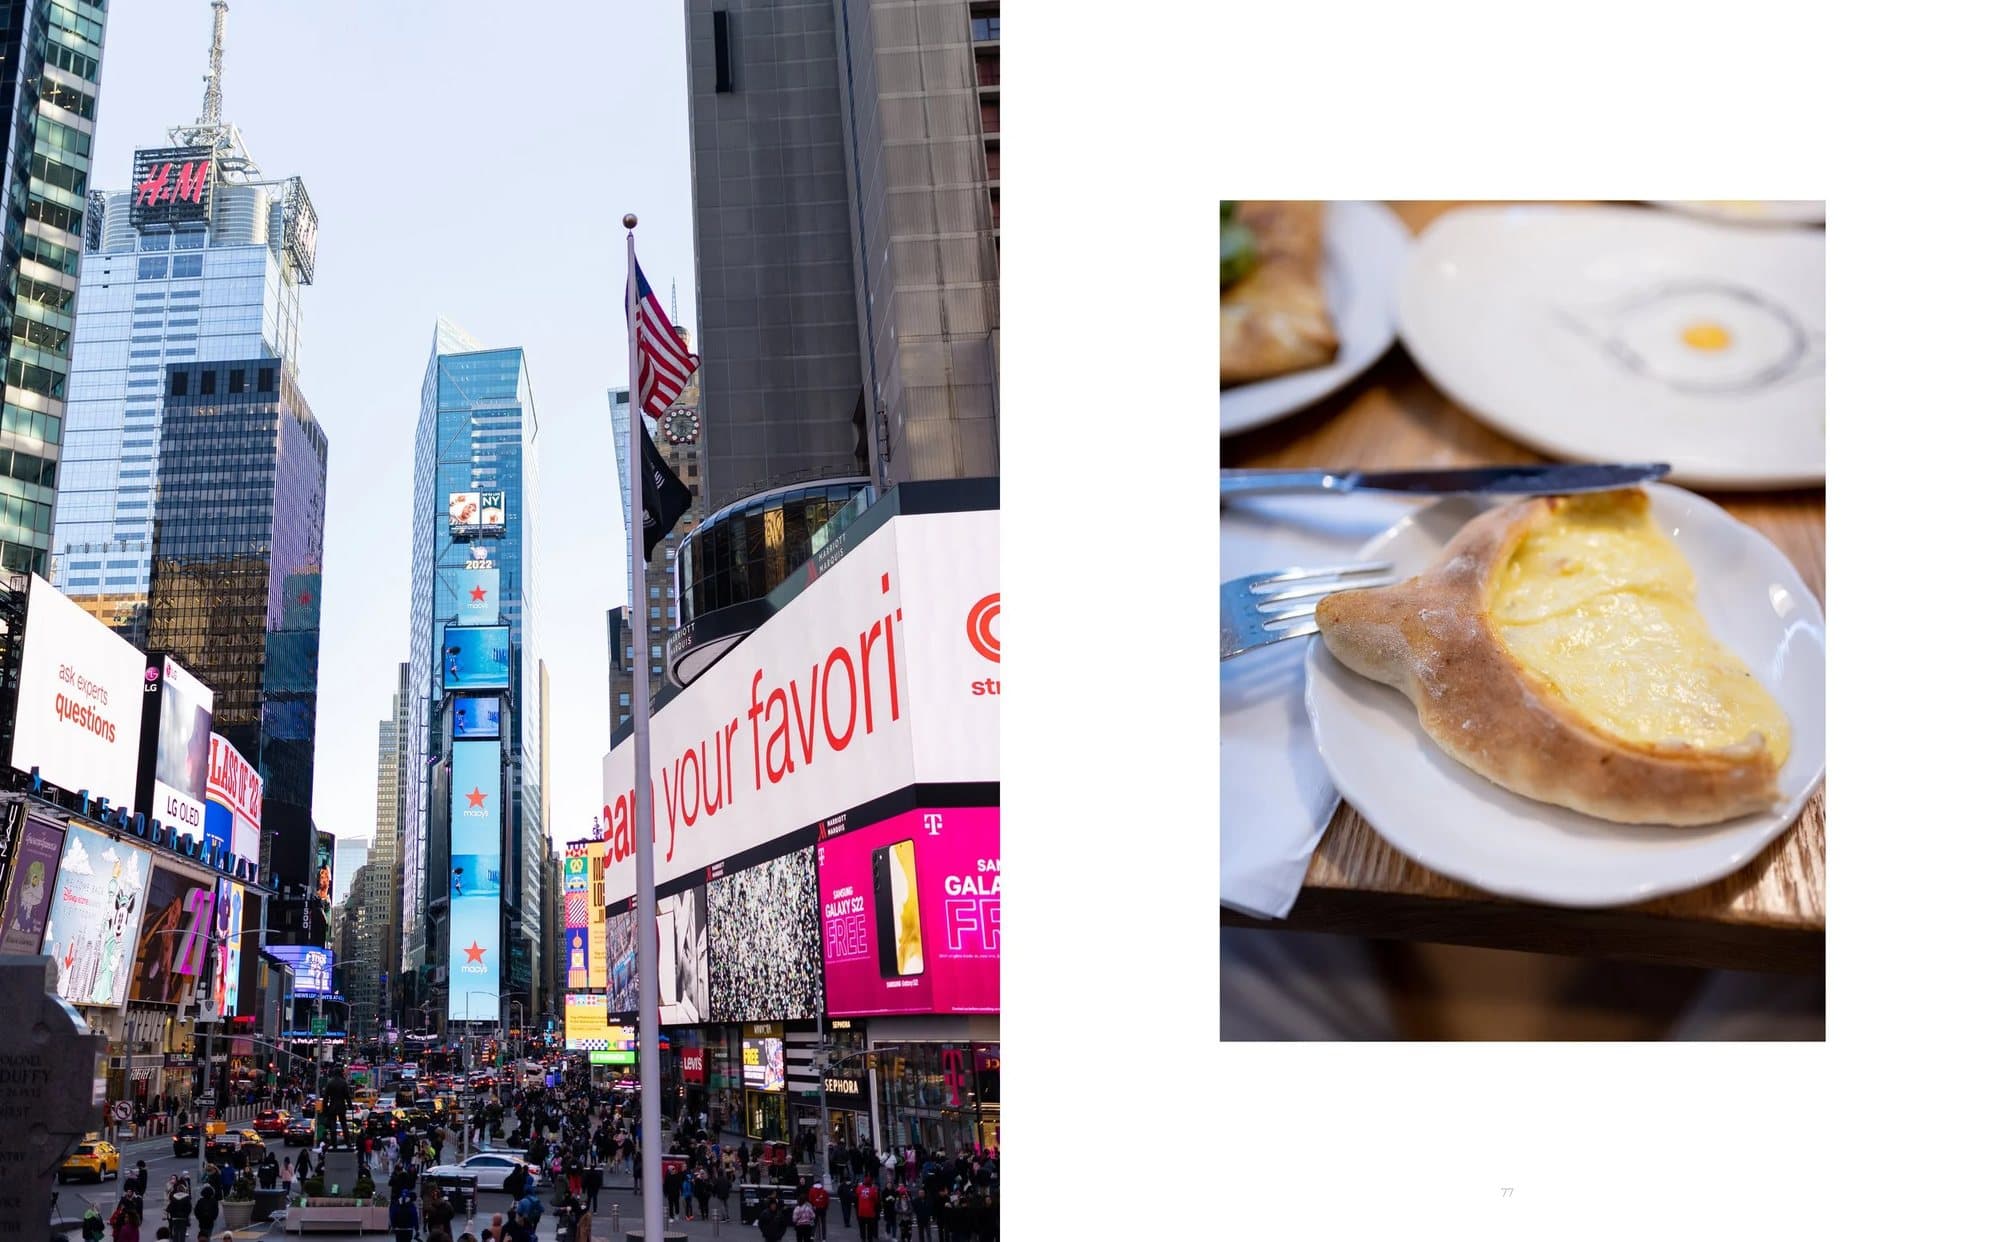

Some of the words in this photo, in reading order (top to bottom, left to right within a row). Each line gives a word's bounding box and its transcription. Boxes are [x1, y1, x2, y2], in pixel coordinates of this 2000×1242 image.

[136, 160, 210, 208] H&M
[482, 496, 500, 506] NY
[465, 560, 492, 570] 2022
[58, 662, 76, 688] ask
[77, 671, 109, 706] experts
[144, 683, 157, 692] LG
[55, 691, 116, 744] questions
[662, 716, 738, 863] your
[748, 571, 903, 790] favori
[207, 738, 238, 797] LASS
[238, 762, 249, 807] OF
[167, 795, 178, 817] LG
[179, 801, 200, 827] OLED
[833, 886, 854, 900] SAMSUNG
[825, 899, 850, 918] GALAXY
[851, 895, 865, 912] S22
[826, 913, 868, 959] FREE
[832, 1020, 851, 1029] SEPHORA
[744, 1048, 760, 1065] FREE
[824, 1078, 859, 1095] SEPHORA
